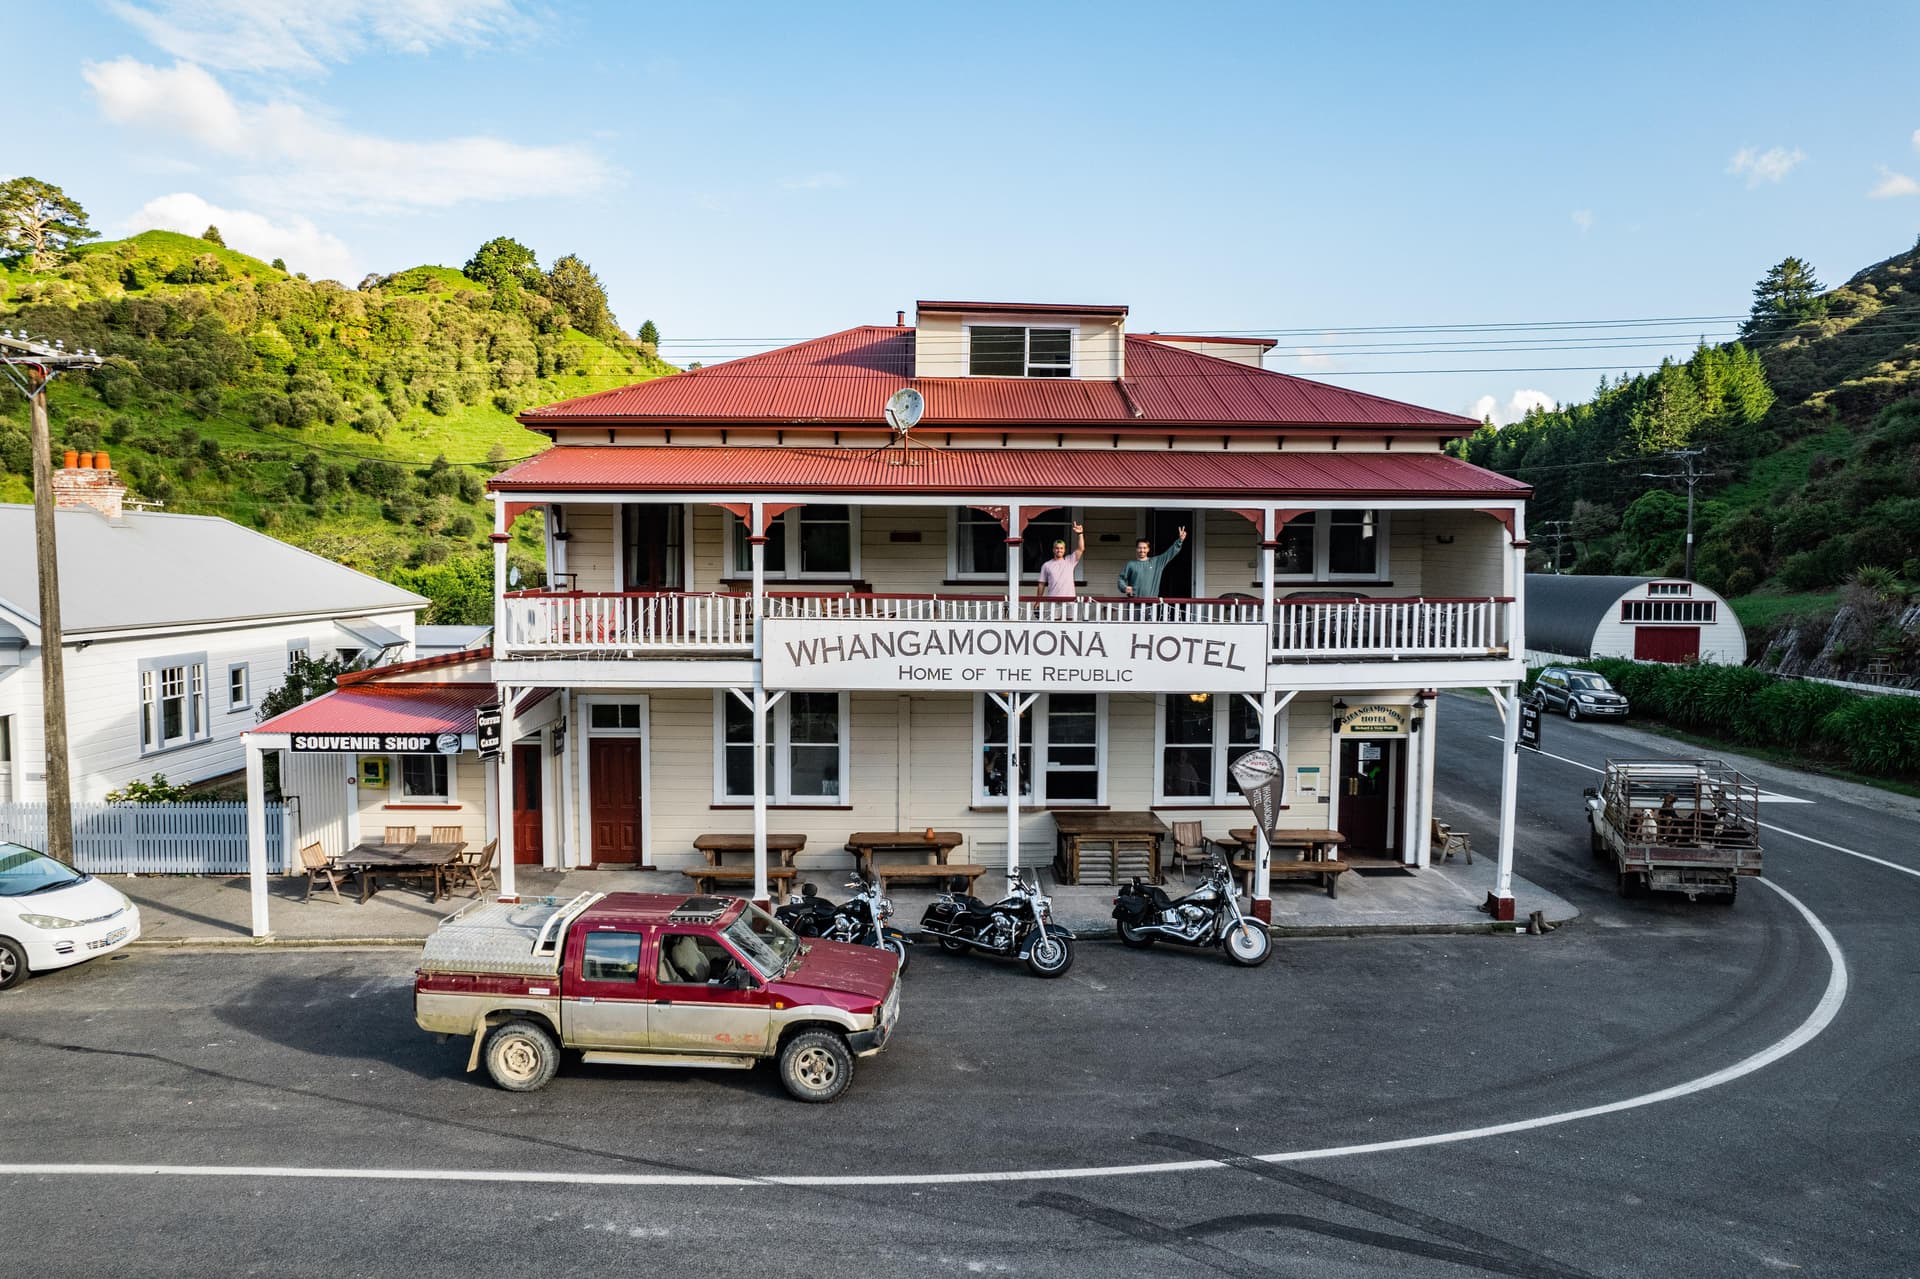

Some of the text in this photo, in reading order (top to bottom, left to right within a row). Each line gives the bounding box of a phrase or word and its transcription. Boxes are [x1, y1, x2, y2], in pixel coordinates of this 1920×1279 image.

[785, 629, 1246, 672] WHANGAMOMONA HOTEL
[898, 665, 1133, 682] HOME OF THE REPUBLIC
[295, 736, 380, 750] SOUVENIR
[385, 736, 431, 750] SHOP
